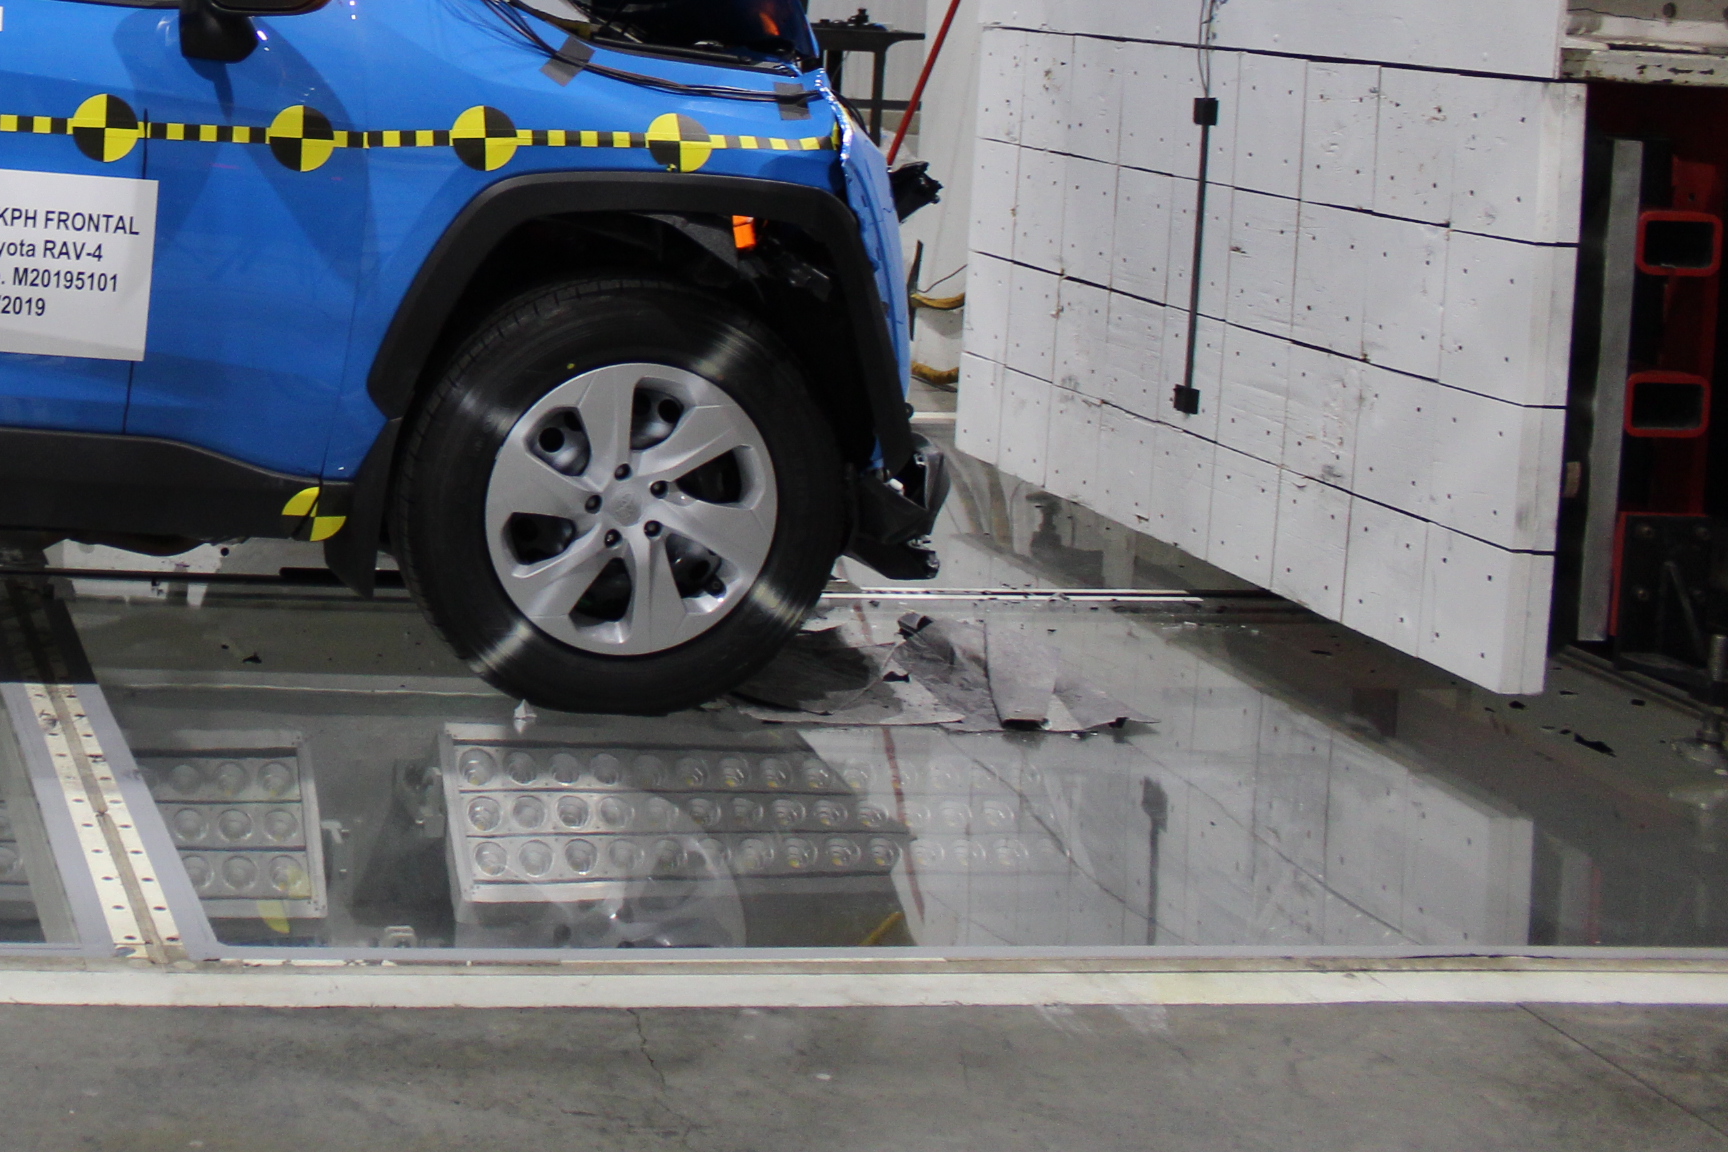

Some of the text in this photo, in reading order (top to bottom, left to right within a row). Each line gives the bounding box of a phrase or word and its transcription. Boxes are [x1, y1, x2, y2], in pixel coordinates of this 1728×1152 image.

[44, 211, 140, 235] FRONTAL
[42, 240, 104, 262] RAV-4
[12, 267, 118, 292] M20195101
